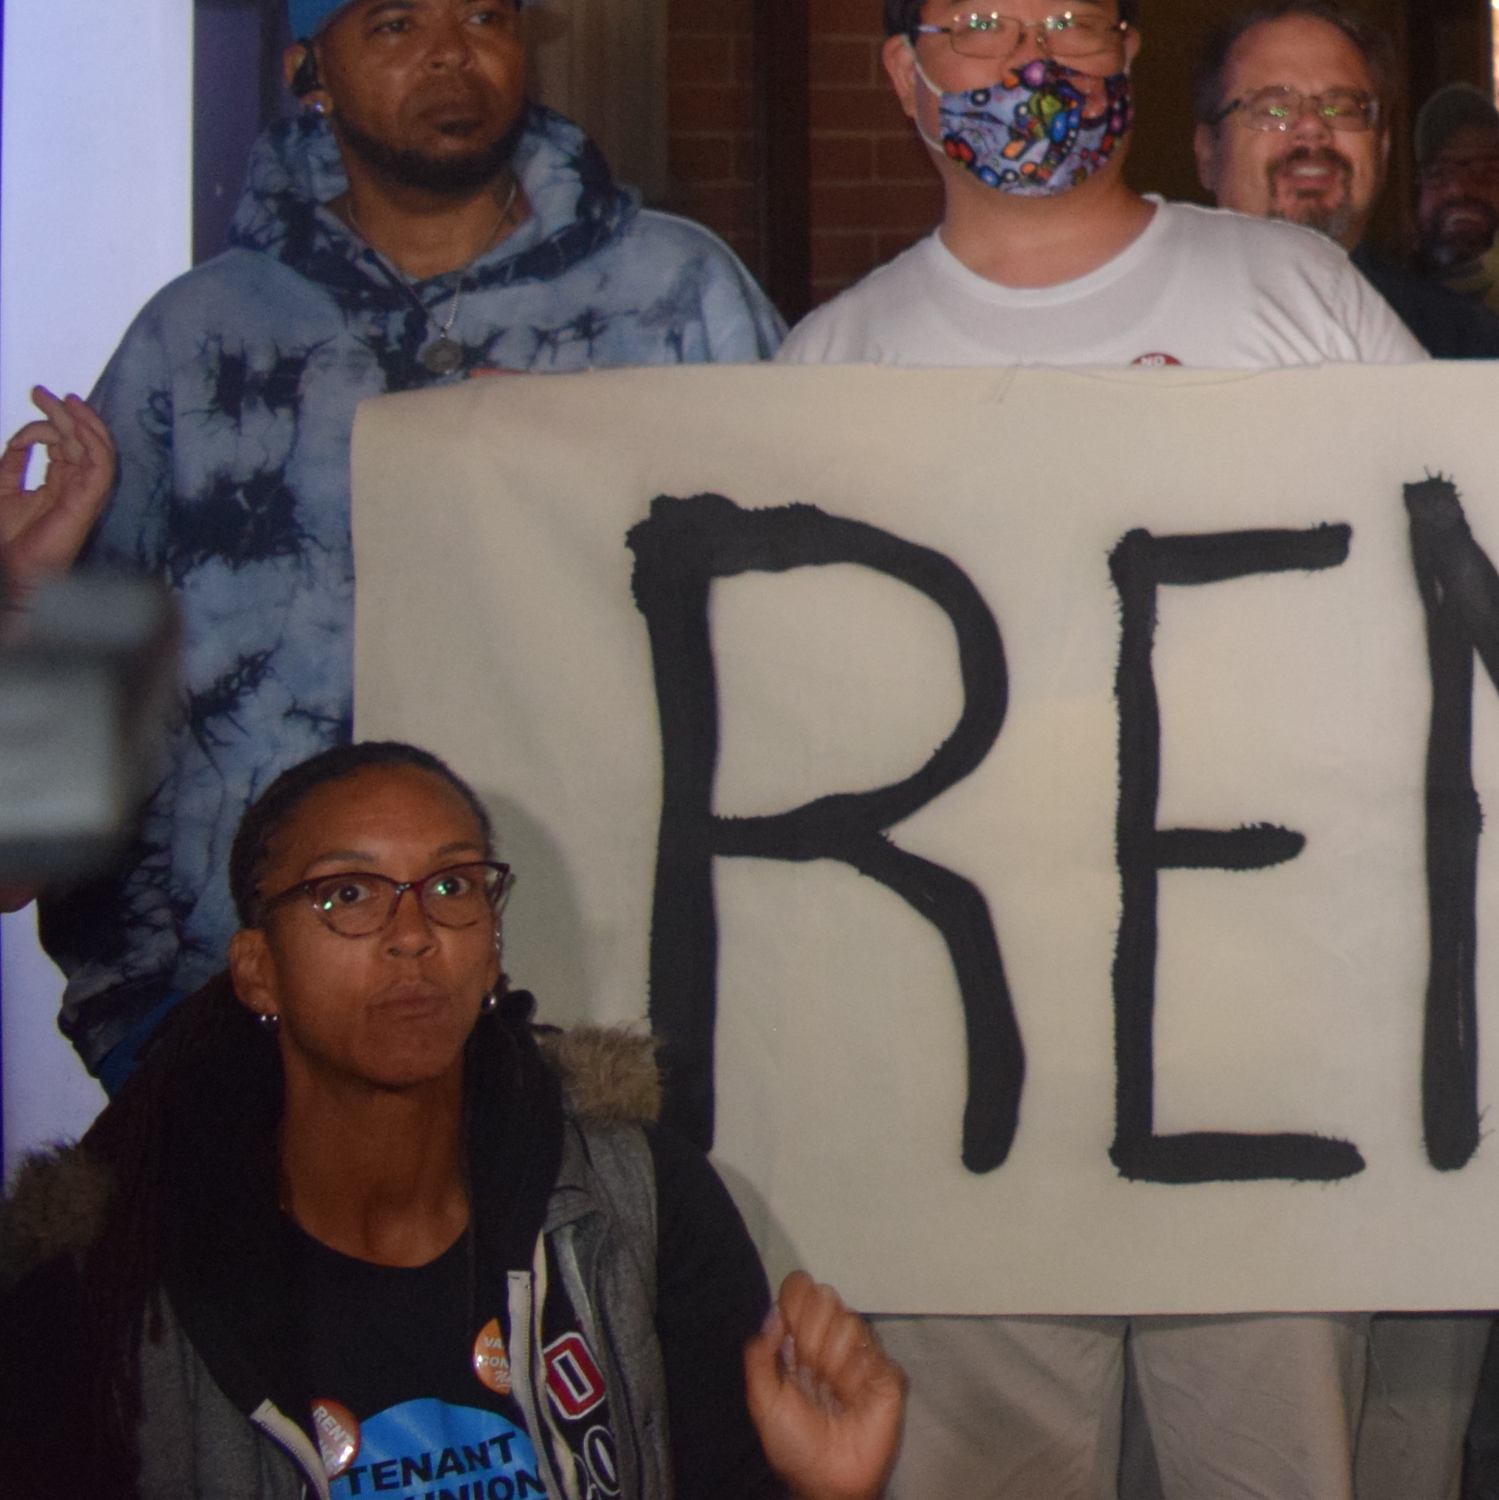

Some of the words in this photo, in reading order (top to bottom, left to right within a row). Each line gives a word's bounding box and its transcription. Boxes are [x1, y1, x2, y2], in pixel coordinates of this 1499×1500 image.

[312, 1405, 355, 1448] RENT
[347, 1431, 516, 1496] TENANT
[404, 1468, 547, 1500] ION
